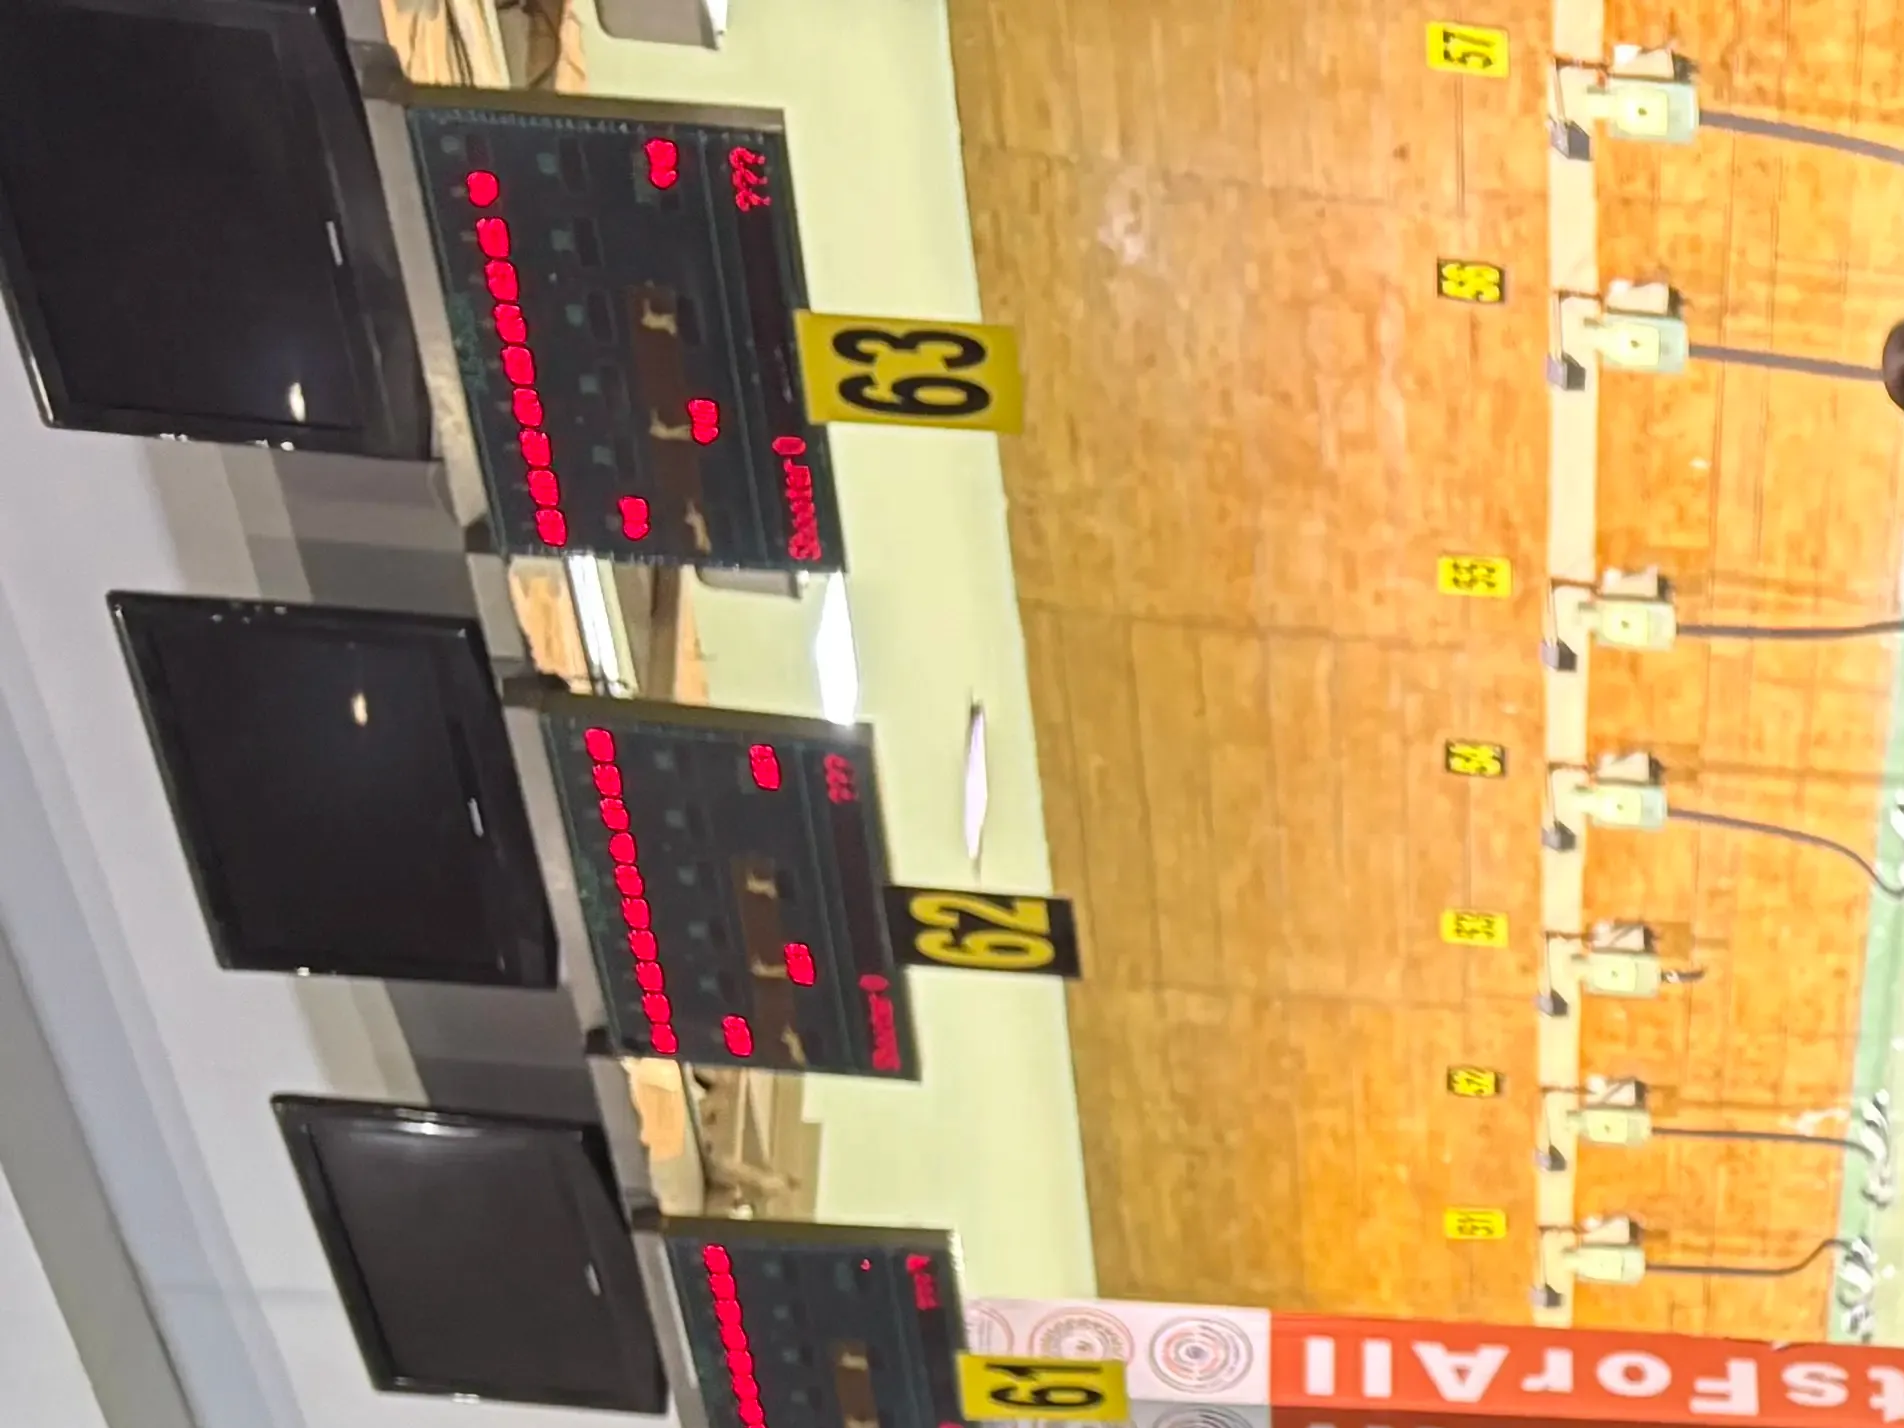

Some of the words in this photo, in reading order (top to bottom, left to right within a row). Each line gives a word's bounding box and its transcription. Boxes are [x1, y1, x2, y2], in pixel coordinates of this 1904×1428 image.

[1443, 31, 1492, 68] 57
[832, 328, 990, 417] 63
[910, 893, 1055, 968] 62
[986, 1362, 1104, 1412] 61
